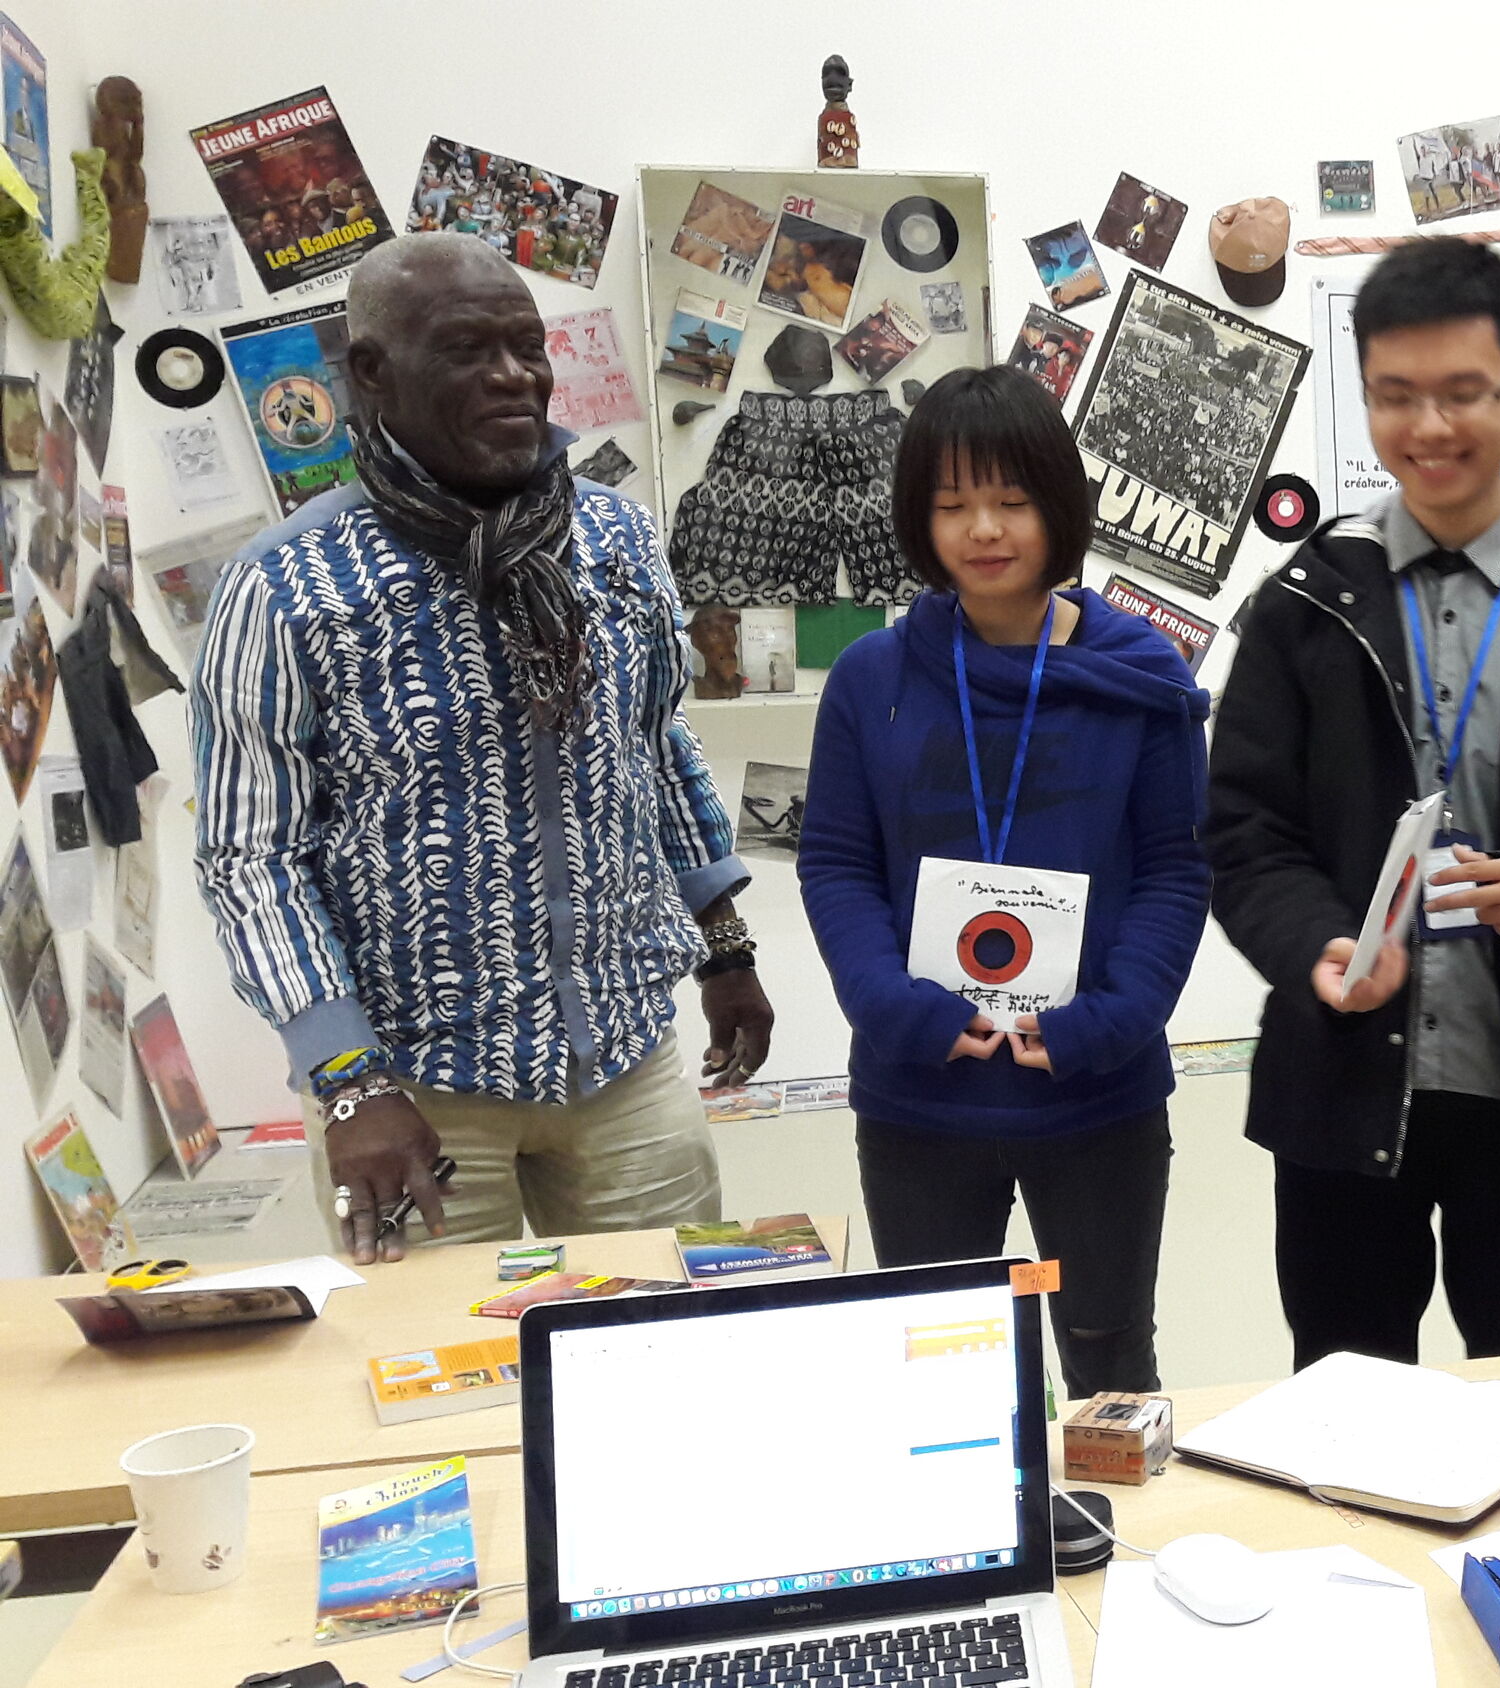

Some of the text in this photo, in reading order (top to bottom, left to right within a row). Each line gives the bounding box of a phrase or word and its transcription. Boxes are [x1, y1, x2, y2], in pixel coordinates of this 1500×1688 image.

[200, 127, 256, 158] JEUNE
[257, 99, 333, 139] AFRIQUE
[783, 195, 816, 219] art
[264, 246, 301, 270] Les
[298, 216, 378, 258] Bantous
[296, 269, 350, 295] EN VENT
[1167, 290, 1189, 308] sich
[1190, 301, 1217, 321] wat!
[1231, 320, 1244, 333] es
[1244, 326, 1270, 344] geht
[1345, 478, 1394, 490] créateur,
[1105, 521, 1116, 535] in
[1149, 541, 1163, 554] ab
[1180, 554, 1217, 576] August
[1107, 585, 1209, 647] JEUNE AFRIQUE
[773, 1601, 824, 1616] MacBook Pro
